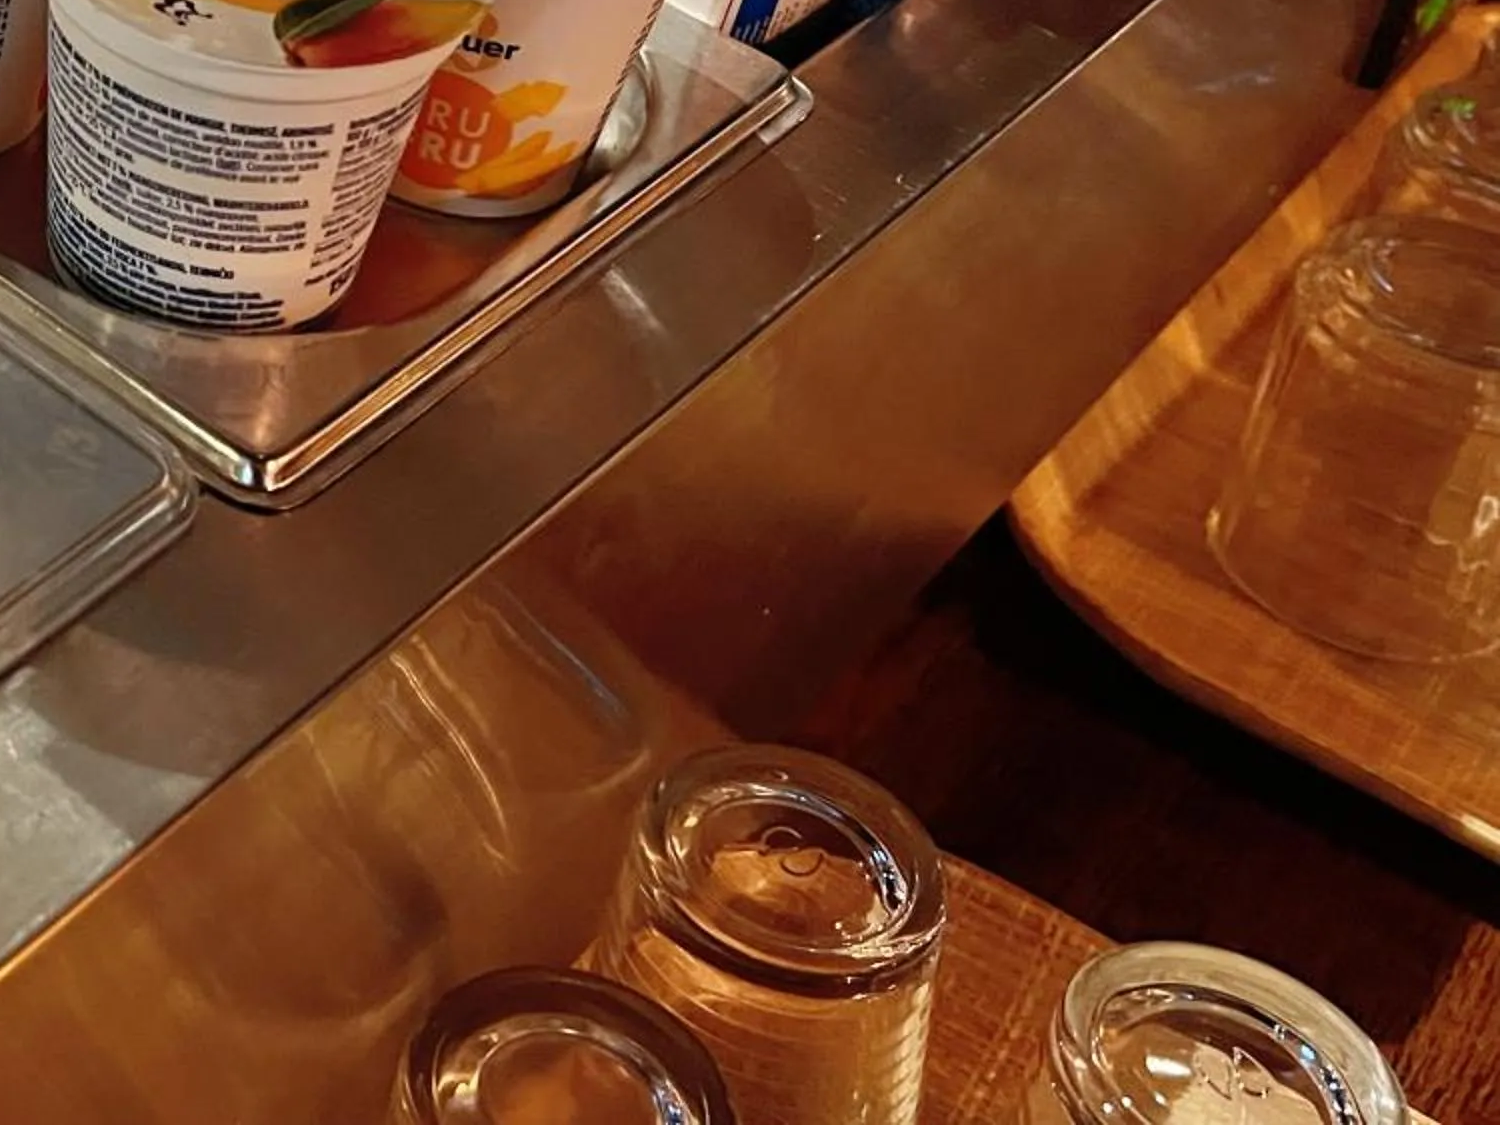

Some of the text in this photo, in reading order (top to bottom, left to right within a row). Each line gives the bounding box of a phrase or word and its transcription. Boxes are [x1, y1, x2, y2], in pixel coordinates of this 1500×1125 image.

[460, 33, 521, 61] uer
[428, 97, 491, 139] RU
[420, 129, 482, 170] RU
